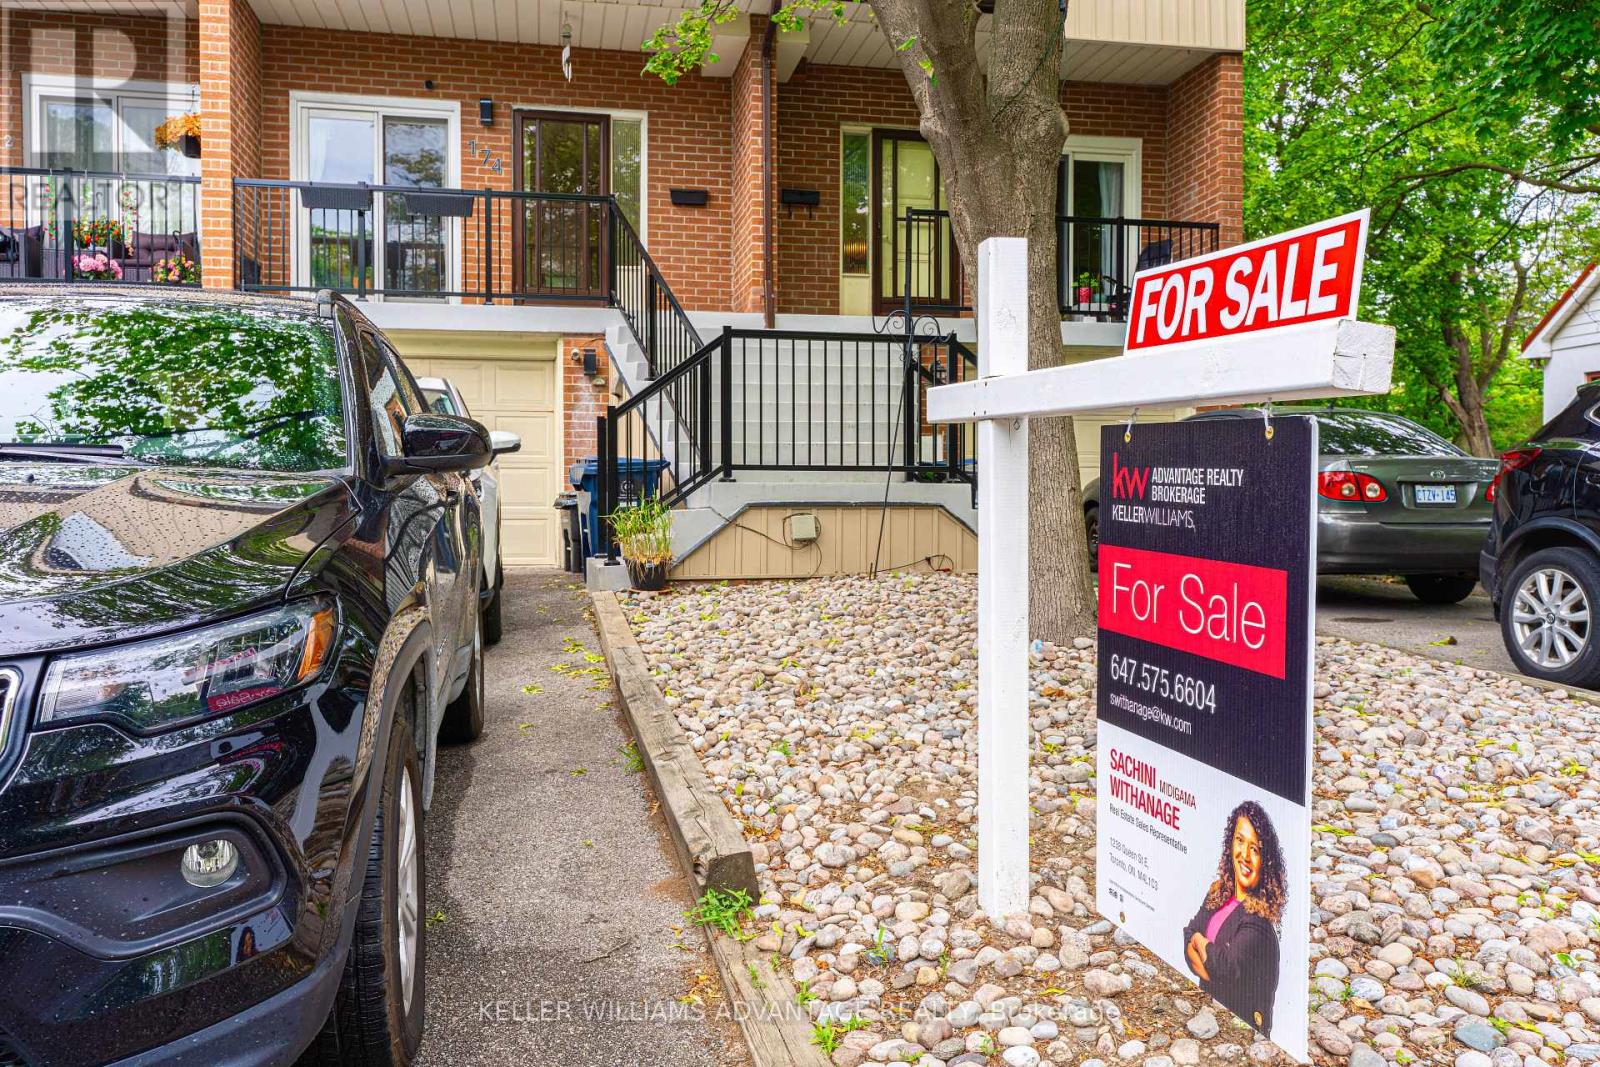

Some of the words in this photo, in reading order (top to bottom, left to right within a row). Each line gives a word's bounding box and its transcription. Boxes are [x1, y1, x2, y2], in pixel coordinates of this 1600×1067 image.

[467, 139, 503, 175] 174
[1136, 266, 1214, 344] FOR
[1219, 230, 1346, 330] SALE
[1112, 451, 1150, 500] kw
[1151, 467, 1204, 485] ADVANTAGE
[1207, 468, 1244, 487] REALTY
[1151, 485, 1206, 505] BROKERAGE
[1113, 562, 1165, 624] For
[1179, 573, 1266, 650] Sale
[1111, 653, 1217, 714] 647.575.6604
[1109, 692, 1192, 736] swithanage@kw.com
[1109, 774, 1180, 831] WITHANAGE
[1110, 748, 1156, 790] SACHINI
[1159, 779, 1197, 810] MIDIGAMA
[1120, 808, 1135, 825] Estate
[1135, 817, 1149, 833] Sales
[1149, 825, 1188, 854] Representative
